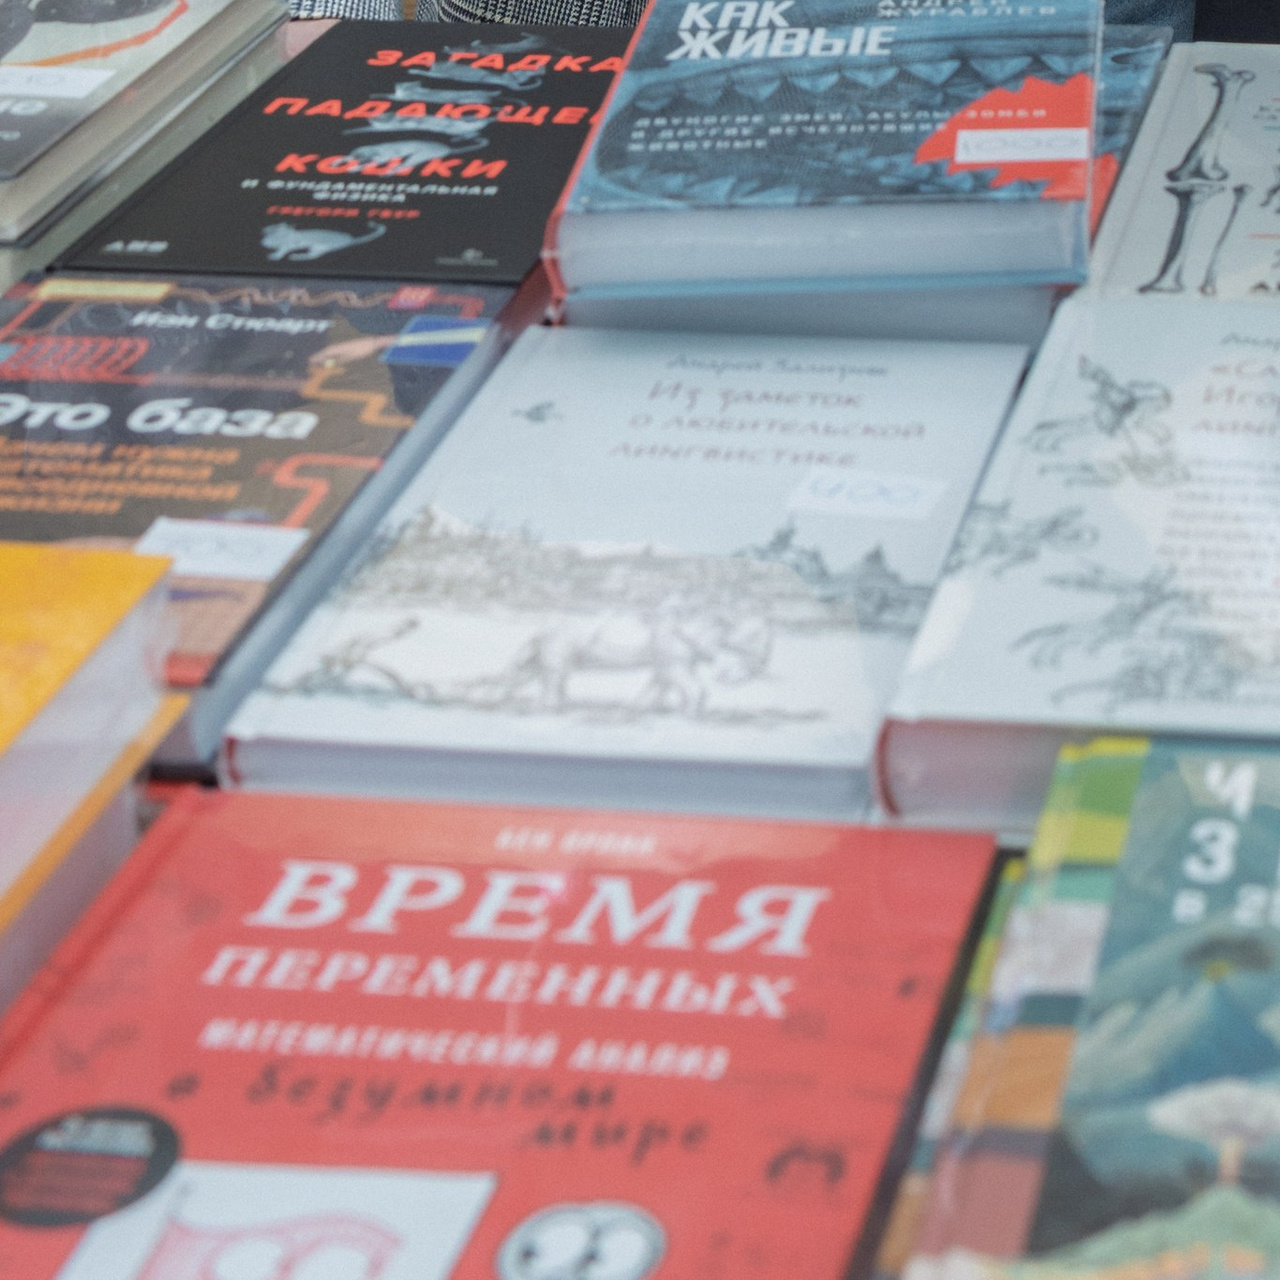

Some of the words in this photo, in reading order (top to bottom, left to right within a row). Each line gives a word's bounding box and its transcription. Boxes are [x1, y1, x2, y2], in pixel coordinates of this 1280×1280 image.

[680, 0, 794, 29] КАК
[666, 26, 896, 60] ЖИВЫЕ
[367, 49, 624, 73] ЗАГАДКА
[276, 154, 508, 179] КОШКИ
[267, 180, 498, 196] ФУНДАМЕНТАЛЬНАЯ
[313, 191, 405, 203] ФИЗИКА
[131, 311, 199, 328] Иэн
[205, 313, 333, 334] Стюарт
[127, 397, 319, 440] база
[245, 859, 832, 959] ВРЕМЯ
[201, 946, 795, 1019] ПЕРЕМЕННЫХ
[201, 1017, 559, 1070] МАТЕМАТИЧЕСКИЙ
[569, 1039, 731, 1081] АНАЛИЗ
